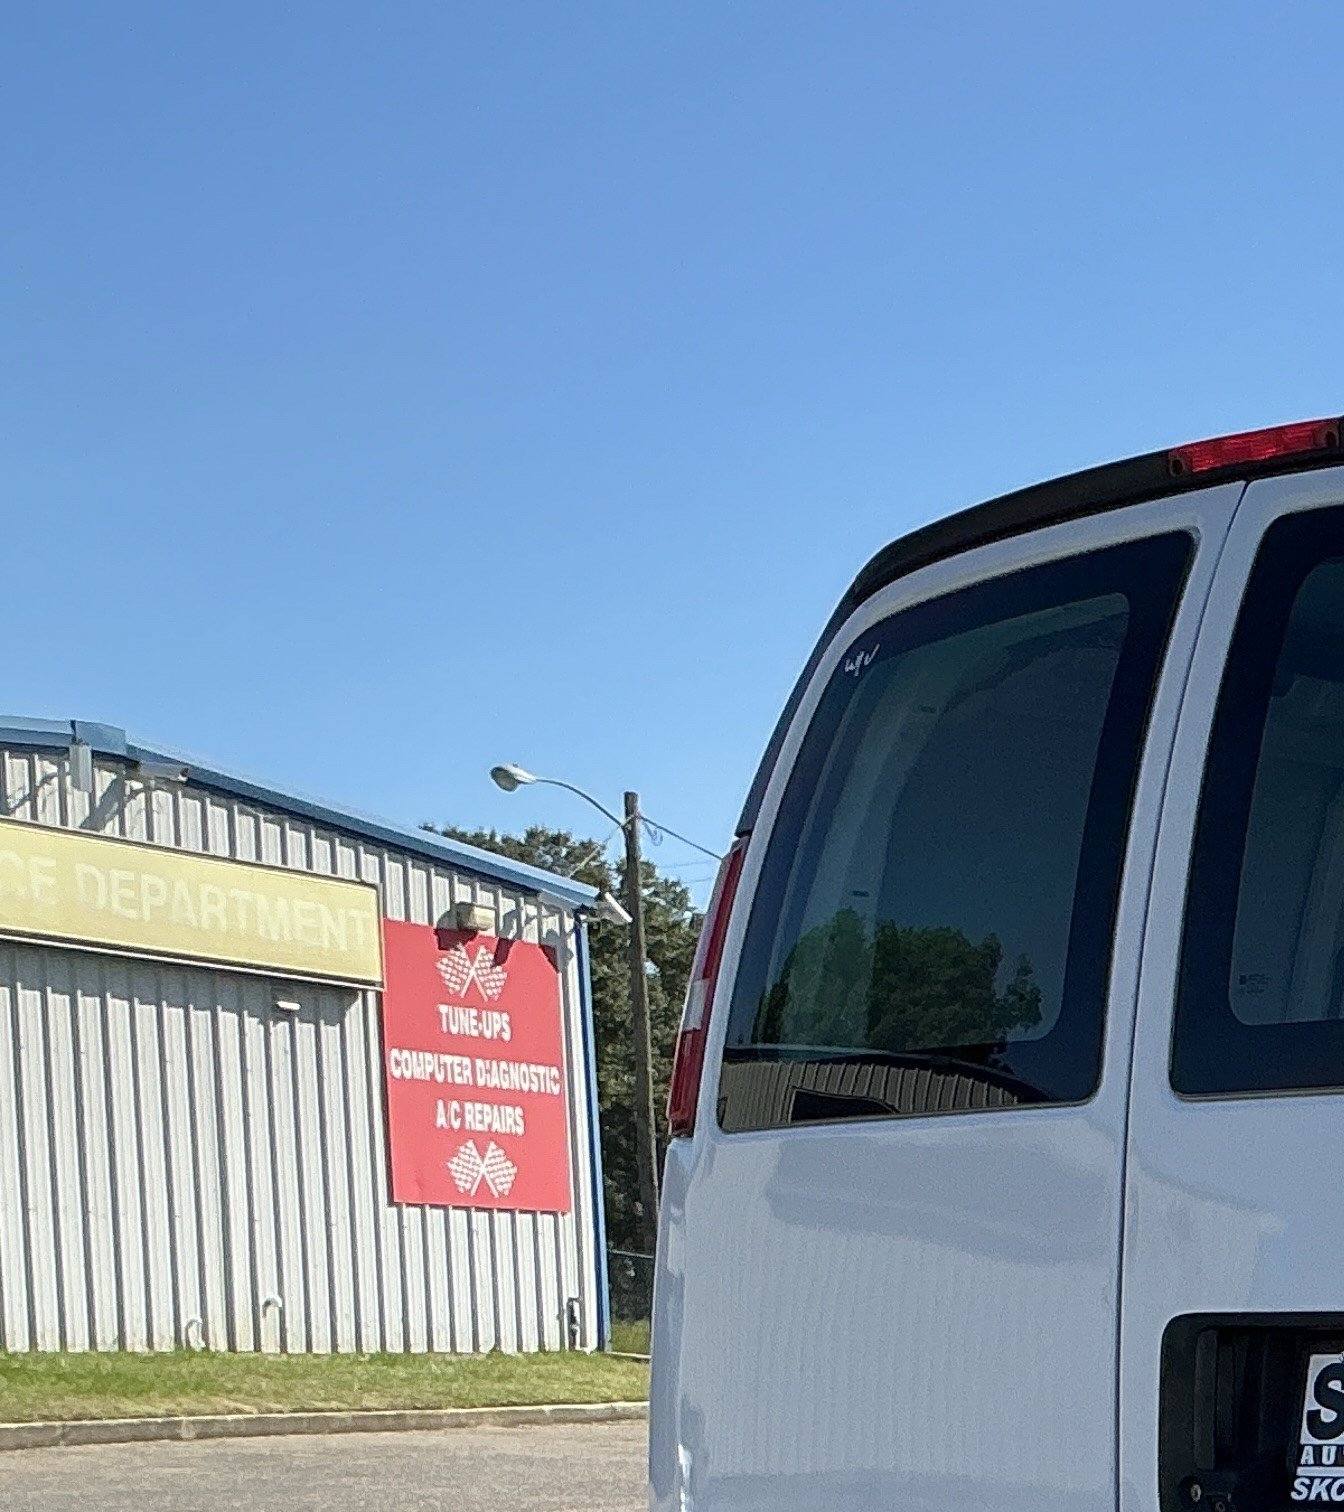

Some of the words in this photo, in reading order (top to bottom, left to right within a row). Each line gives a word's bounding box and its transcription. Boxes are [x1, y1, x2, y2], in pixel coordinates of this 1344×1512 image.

[75, 863, 370, 951] DEPARTMENT
[438, 1004, 512, 1042] TUNE-UPS
[390, 1048, 473, 1085] COMPUTER
[475, 1058, 561, 1095] DIAGNOSTIC
[436, 1099, 461, 1129] A/C
[464, 1101, 525, 1136] REPAIRS
